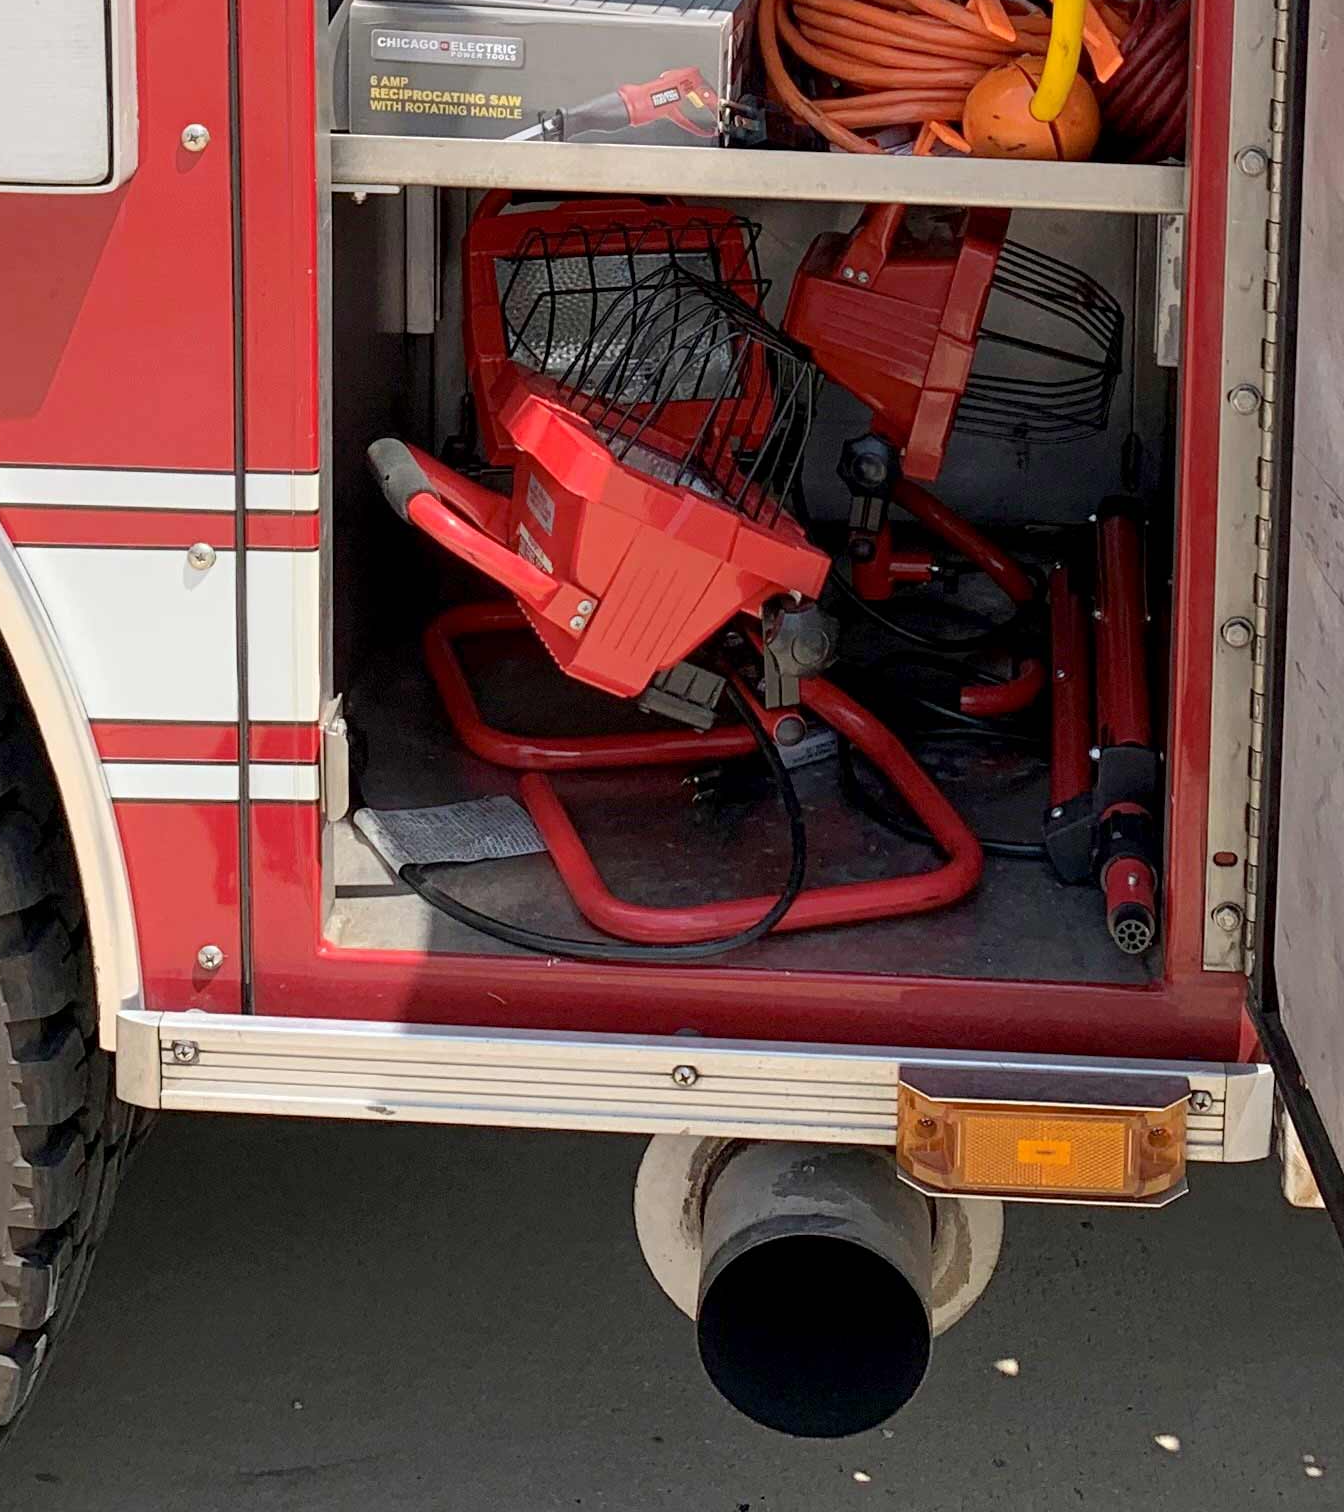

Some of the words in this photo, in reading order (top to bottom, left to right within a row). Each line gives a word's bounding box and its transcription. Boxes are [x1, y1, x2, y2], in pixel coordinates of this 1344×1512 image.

[377, 37, 439, 50] CHICAGO
[450, 41, 517, 54] ELECTRIC
[450, 51, 483, 59] POWER
[486, 53, 517, 61] TOOLS
[370, 75, 377, 86] 6
[380, 76, 409, 87] AMP
[370, 87, 486, 105] RECIPROCATING
[489, 95, 523, 106] SAW
[370, 100, 402, 112] WITH
[405, 102, 467, 116] ROTATING
[471, 107, 523, 120] HANDLE
